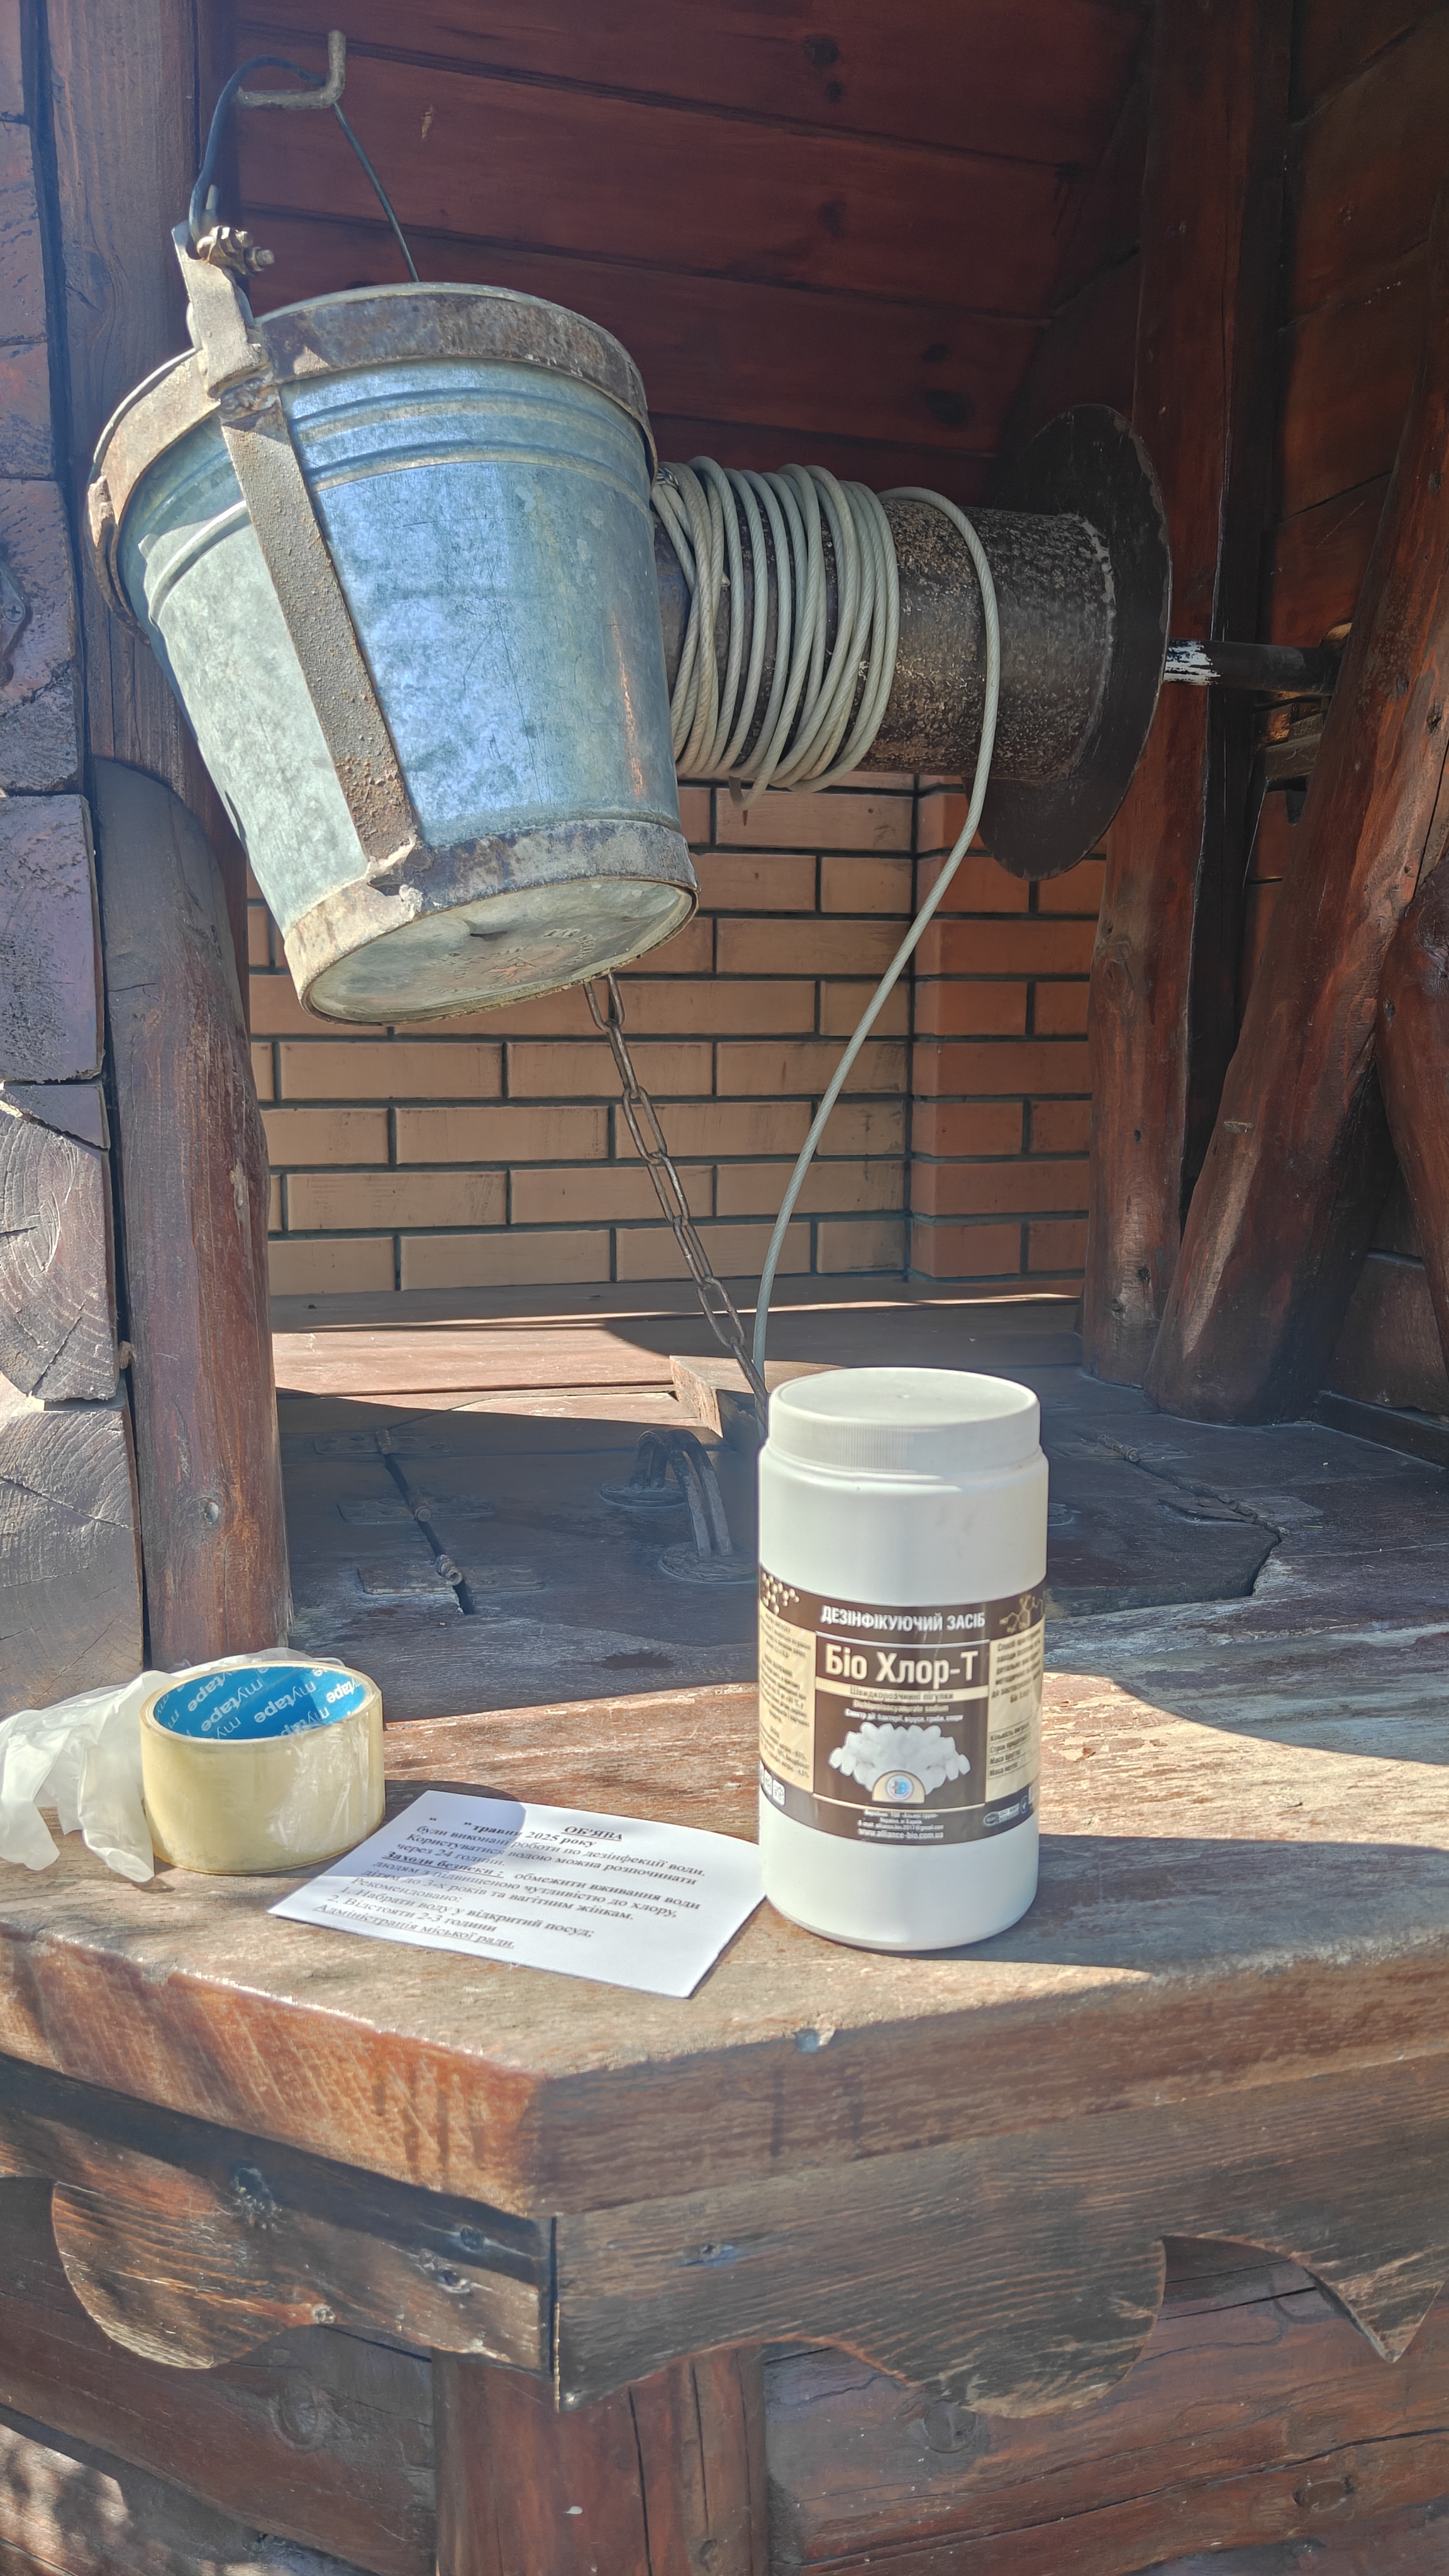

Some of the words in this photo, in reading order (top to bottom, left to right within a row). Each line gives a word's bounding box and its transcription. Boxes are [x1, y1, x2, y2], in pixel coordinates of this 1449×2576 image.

[820, 1605, 943, 1631] ДЕЗІНФІКУЮЧИЙ
[946, 1612, 985, 1631] ЗАСІБ
[825, 1642, 868, 1680] Біо
[875, 1650, 979, 1689] Хлор-Т
[188, 1670, 237, 1711] ytape
[201, 1679, 263, 1731] mytape
[254, 1681, 316, 1723] mytape
[397, 1843, 434, 1855] через
[435, 1849, 454, 1858] 24
[416, 1825, 448, 1836] були
[449, 1831, 513, 1846] виконані
[511, 1841, 561, 1853] роботи
[564, 1847, 582, 1855] по
[583, 1850, 669, 1868] дезінфекції
[667, 1863, 706, 1877] води.
[526, 1831, 559, 1841] 2025
[559, 1838, 596, 1848] року
[508, 1852, 553, 1863] водою
[555, 1857, 602, 1869] можна
[603, 1864, 698, 1885] розпочинати
[353, 1889, 416, 1907] Набрати
[417, 1901, 453, 1913] воду
[467, 1909, 544, 1928] відкритий
[423, 1879, 447, 1889] 3-х
[447, 1885, 488, 1896] років
[509, 1894, 574, 1910] вагітним
[514, 1872, 587, 1889] обмежити
[589, 1883, 662, 1902] вживання
[664, 1897, 702, 1911] води
[525, 1885, 606, 1902] чутливістю
[607, 1898, 628, 1908] до
[631, 1902, 677, 1919] хлору,
[326, 1894, 340, 1902] 2.
[343, 1897, 416, 1919] Відстояти
[418, 1912, 444, 1924] 2-3
[444, 1918, 497, 1932] години
